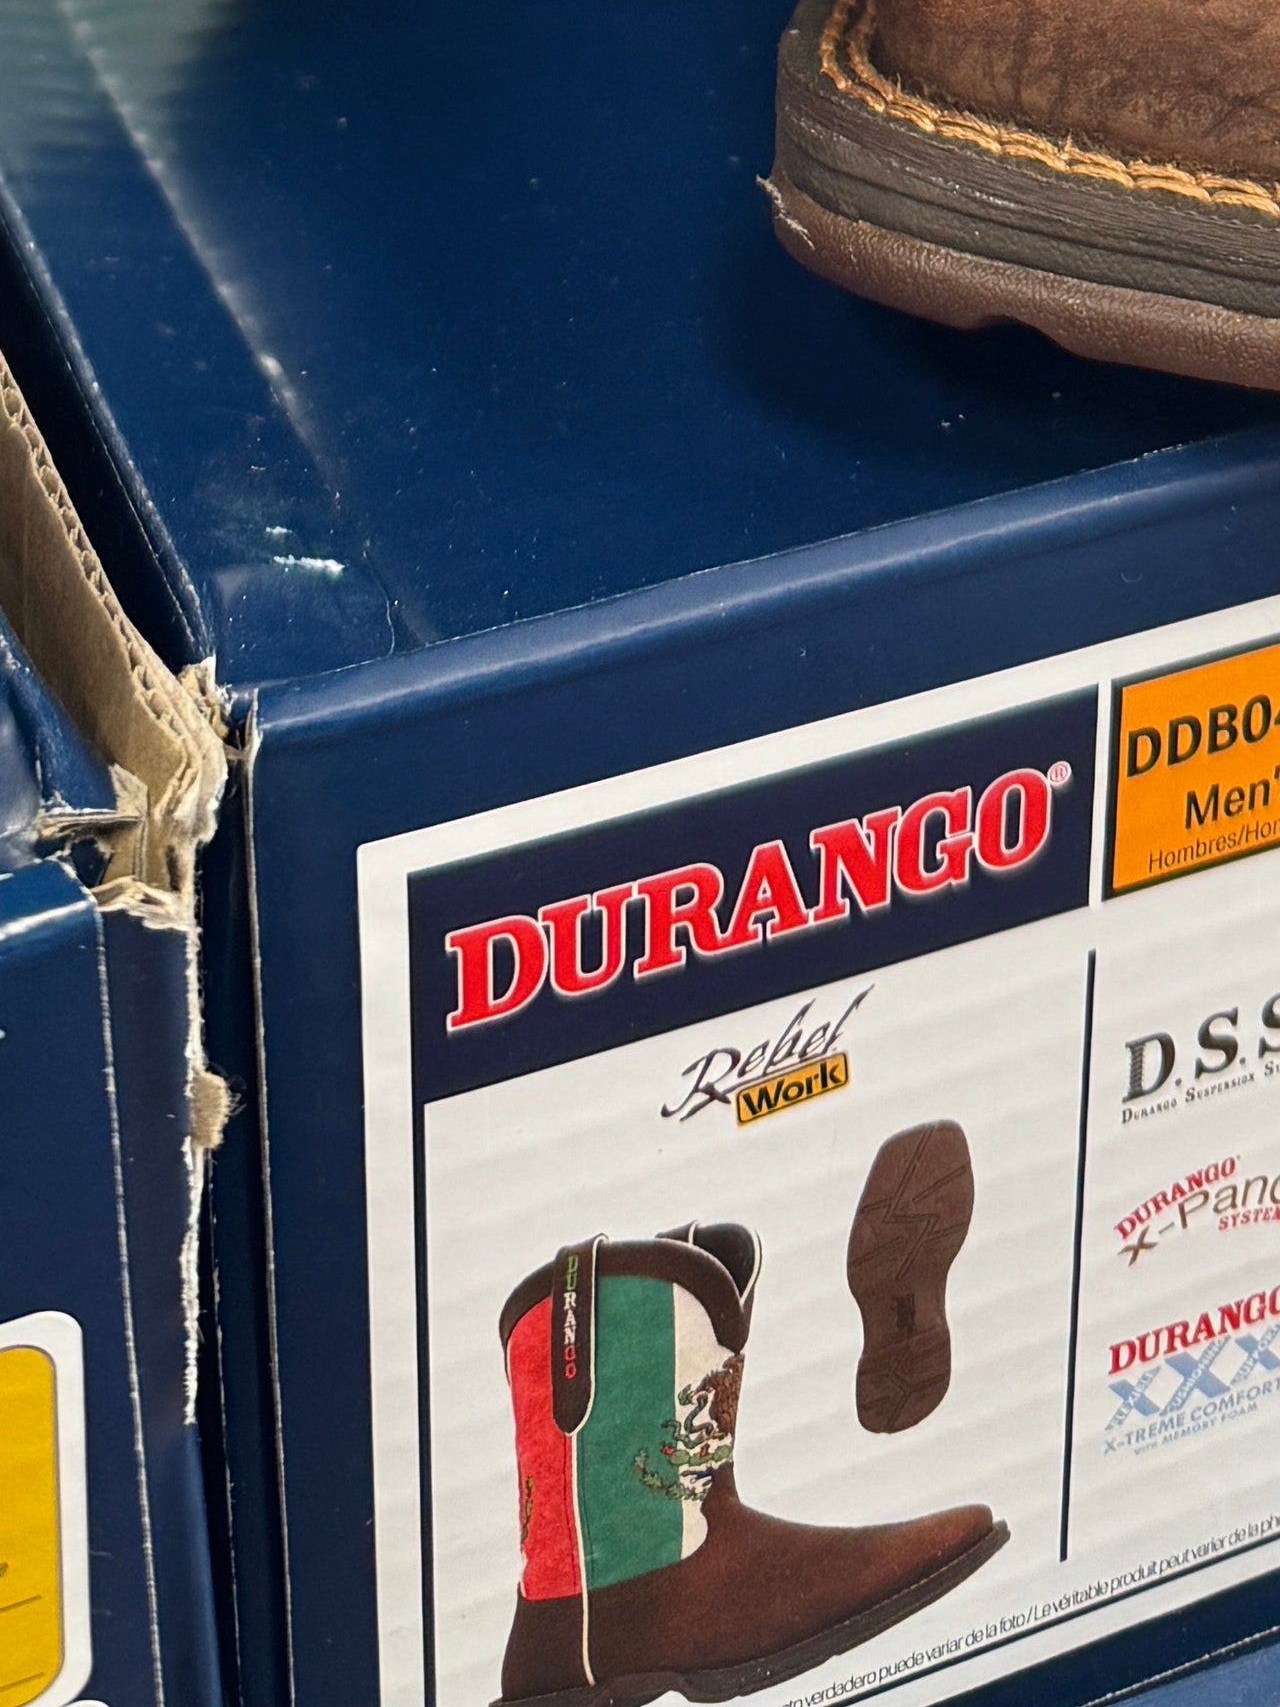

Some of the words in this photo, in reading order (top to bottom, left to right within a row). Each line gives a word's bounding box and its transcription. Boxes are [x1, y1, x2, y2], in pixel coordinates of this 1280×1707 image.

[660, 983, 876, 1123] Rebel
[741, 1061, 844, 1117] Work
[562, 1254, 580, 1381] DURANGO
[1104, 1411, 1186, 1455] X-TREME
[1161, 1418, 1219, 1446] MEMORY
[1220, 1401, 1259, 1424] FOAM
[805, 1671, 878, 1707] verdadero
[878, 1650, 925, 1683] puede
[965, 1628, 984, 1647] de
[985, 1621, 998, 1640] la
[999, 1611, 1026, 1635] foto
[1034, 1602, 1053, 1622] Le
[1109, 1561, 1158, 1596] produit
[1158, 1546, 1192, 1578] peut
[1191, 1533, 1228, 1560] varier
[1228, 1527, 1247, 1545] de
[1247, 1522, 1260, 1539] la
